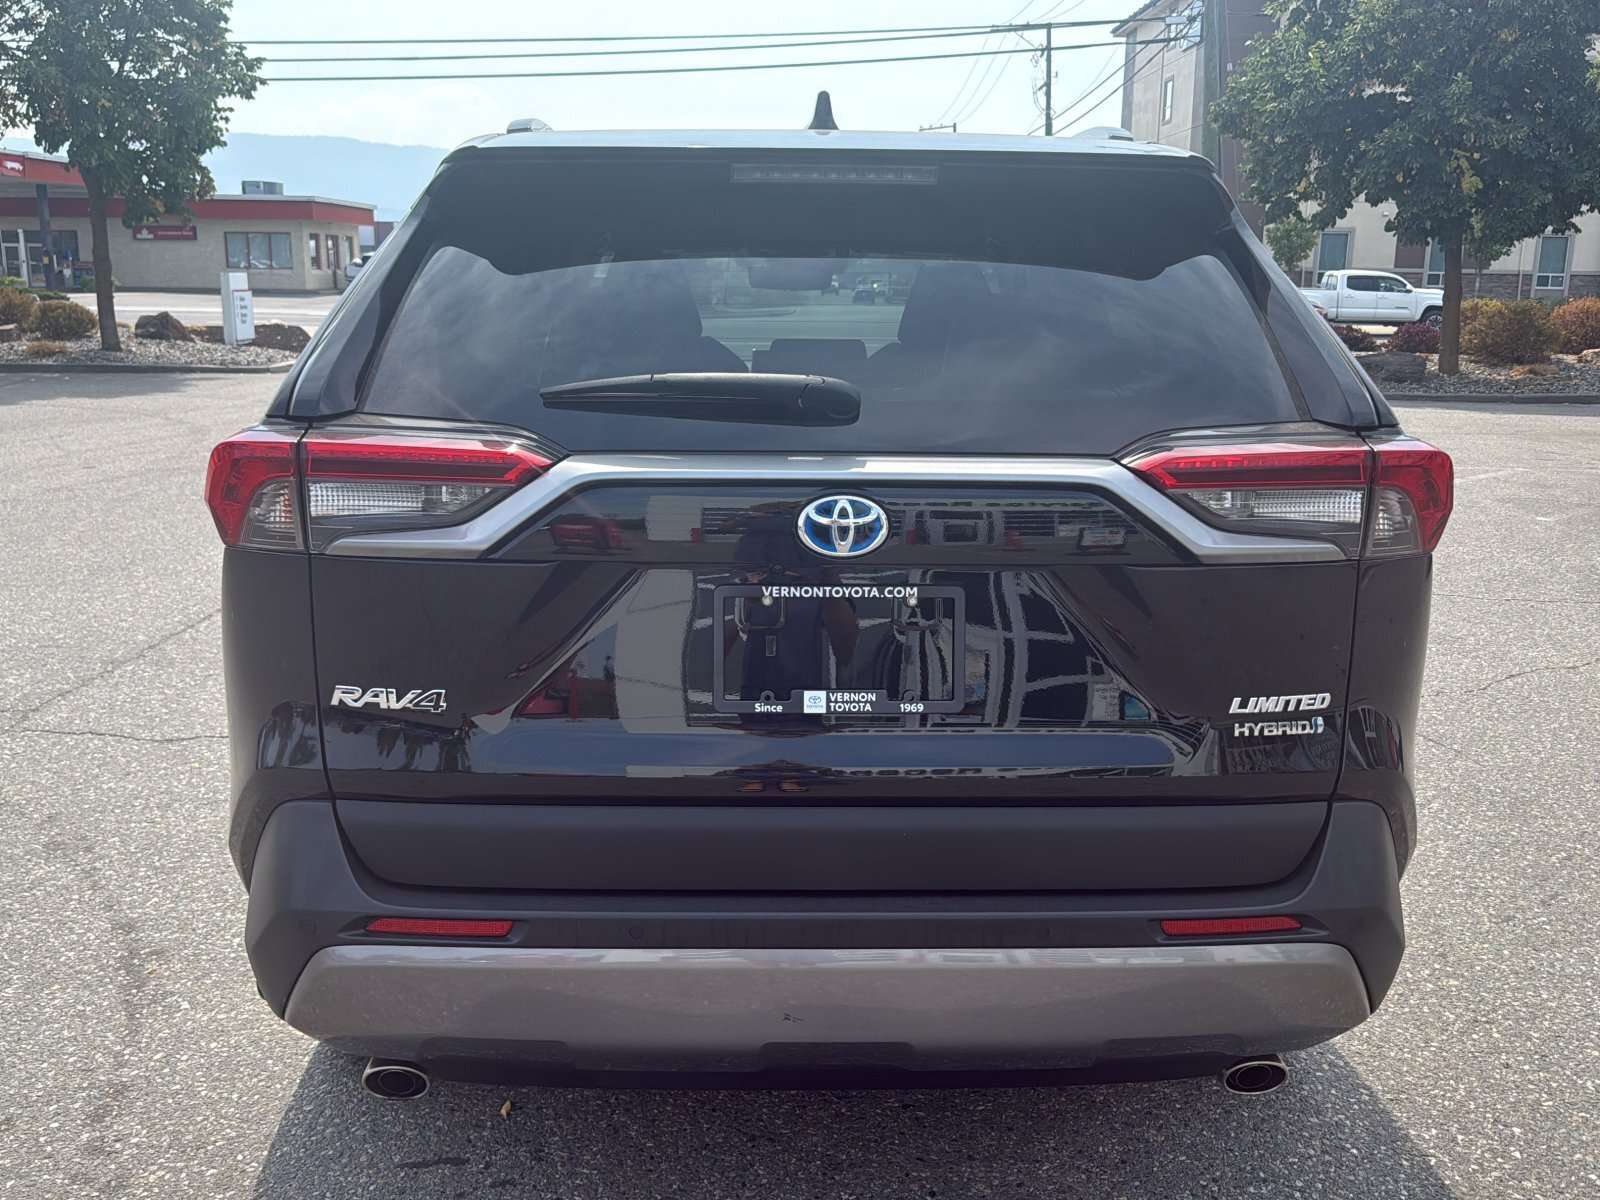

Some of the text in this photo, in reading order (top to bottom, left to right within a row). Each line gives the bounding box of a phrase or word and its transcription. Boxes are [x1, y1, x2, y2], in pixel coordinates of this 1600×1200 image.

[762, 586, 918, 598] VERNONTOYOTA.COM
[330, 685, 447, 713] RAV4
[829, 693, 876, 702] VERNON
[754, 703, 783, 712] Since
[829, 702, 872, 712] TOYOTA
[899, 703, 924, 712] 1969
[1229, 693, 1331, 714] LIMITED
[1234, 721, 1313, 737] HYBRID
